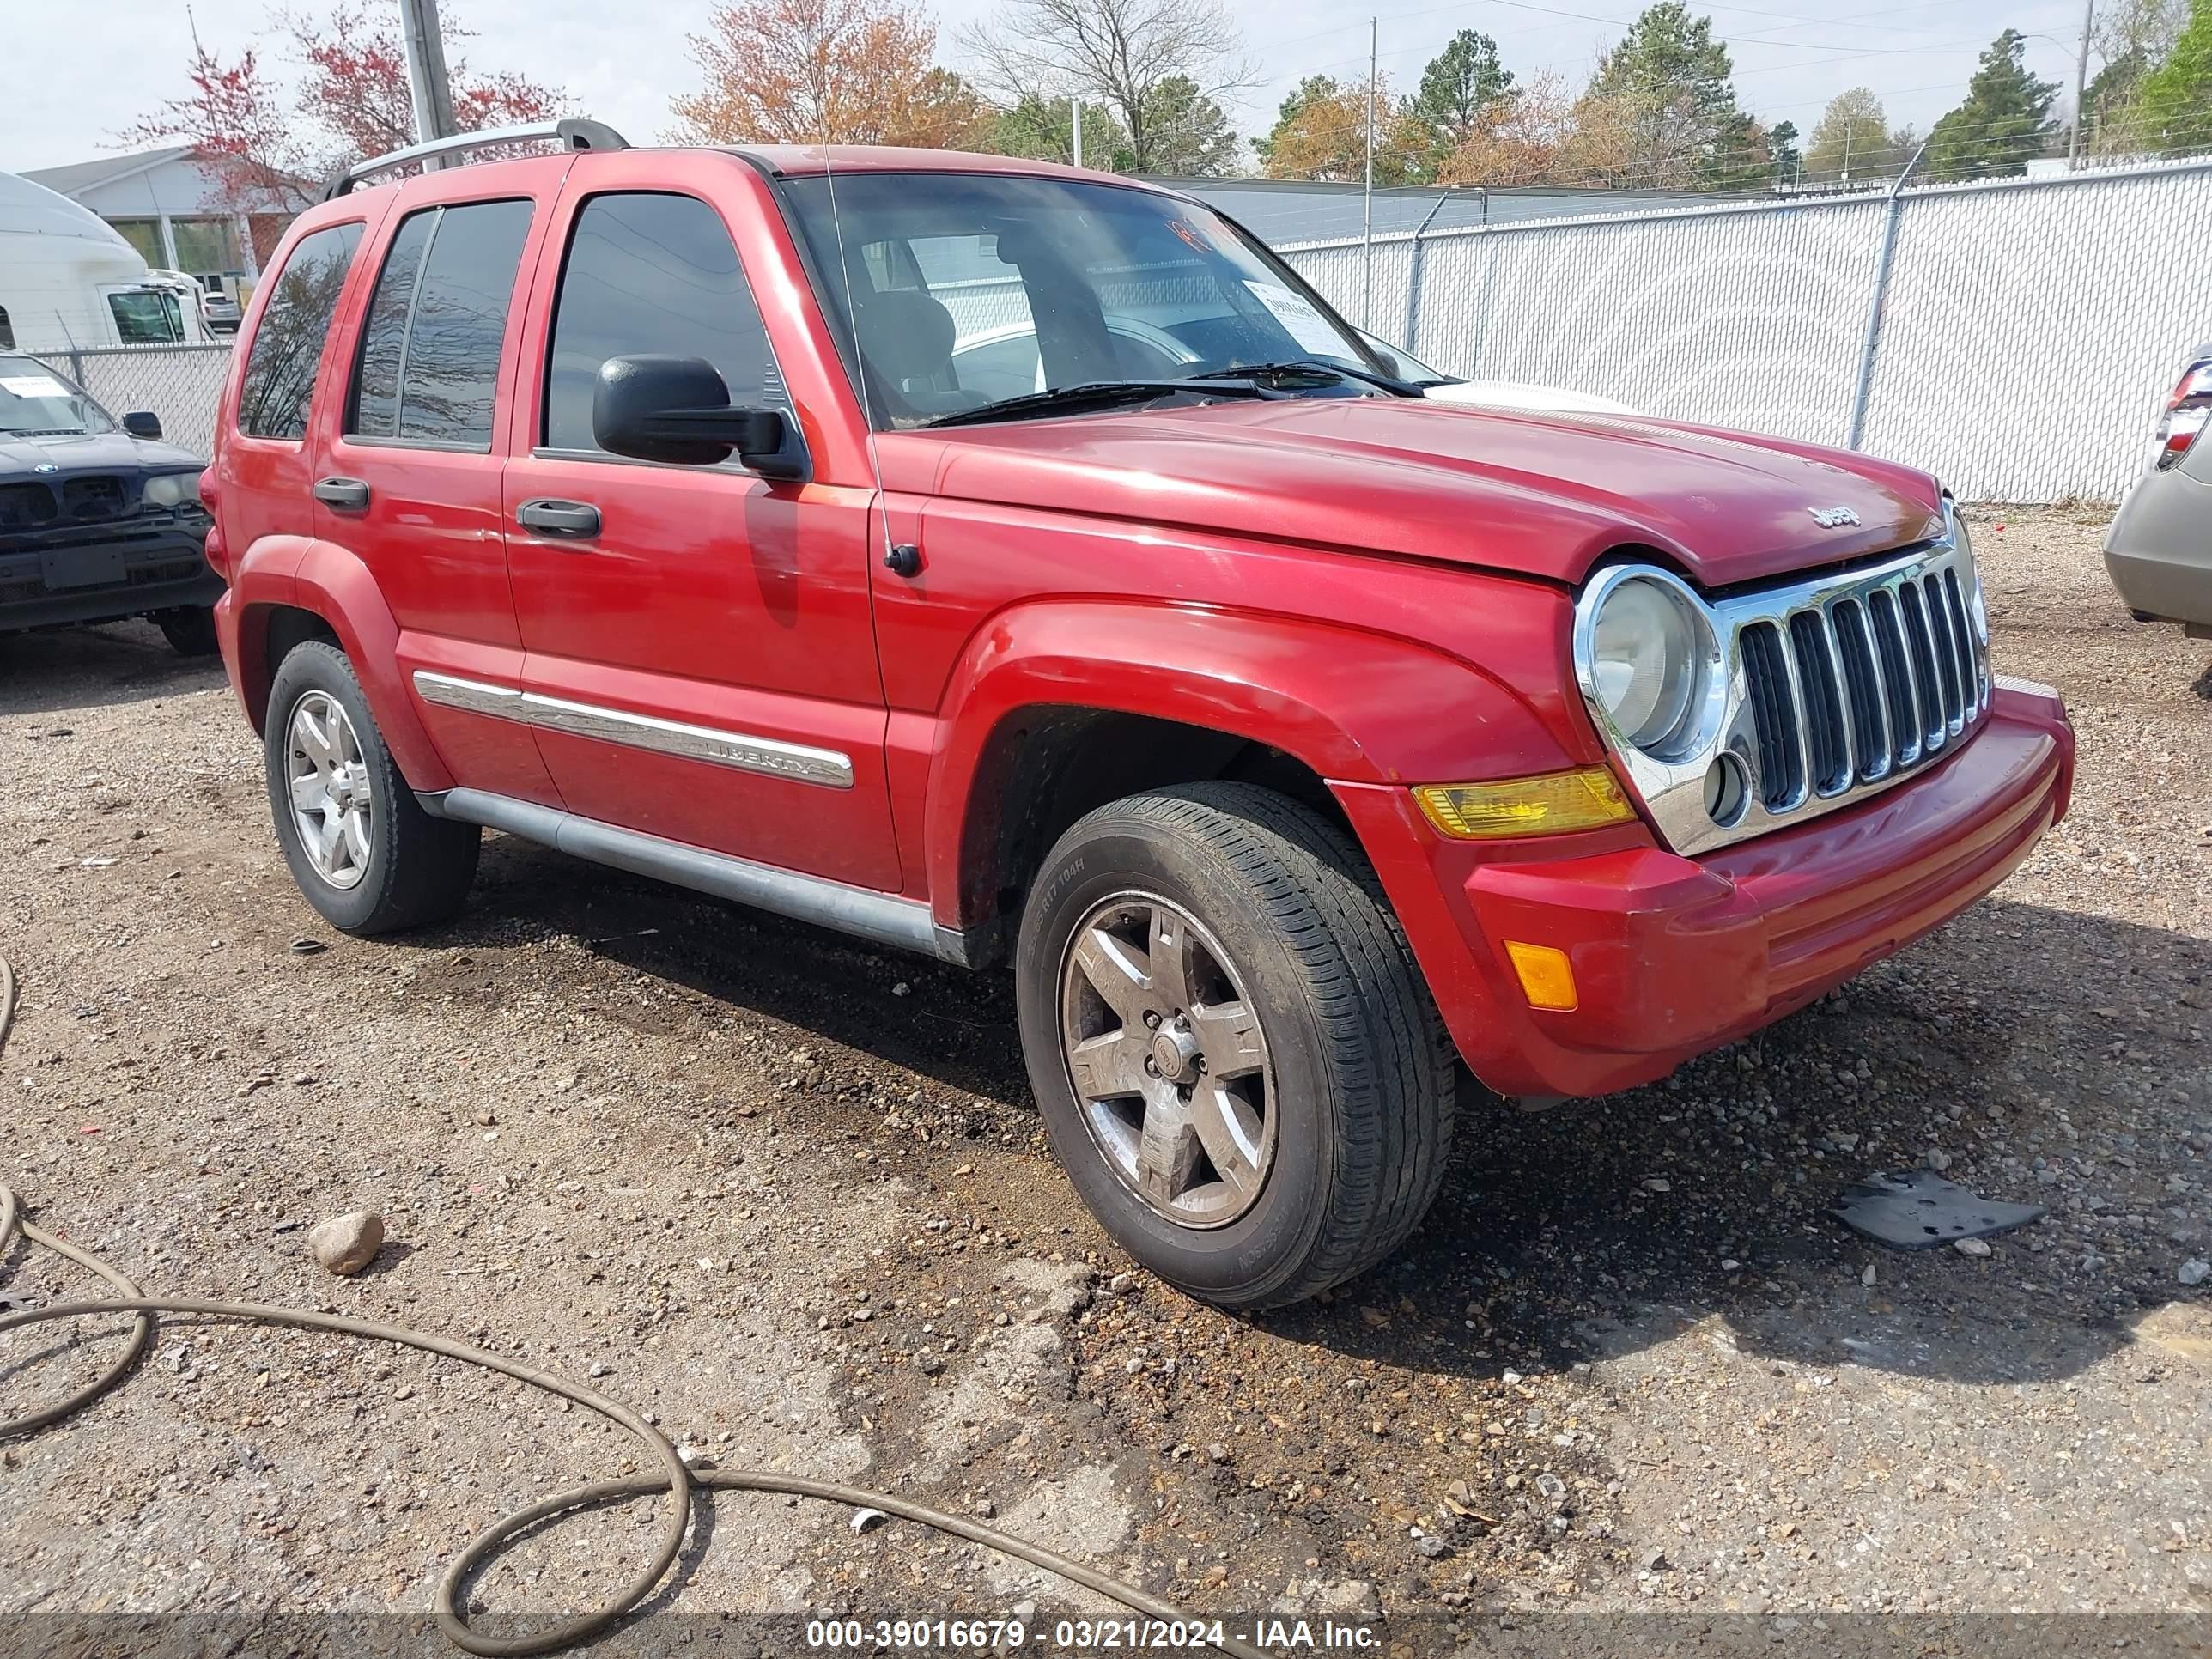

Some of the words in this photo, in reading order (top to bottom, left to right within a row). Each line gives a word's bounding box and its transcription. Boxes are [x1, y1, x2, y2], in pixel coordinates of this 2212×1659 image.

[1807, 507, 1862, 528] Jeep
[705, 742, 809, 775] LIBERTY
[1058, 857, 1085, 887] 104H
